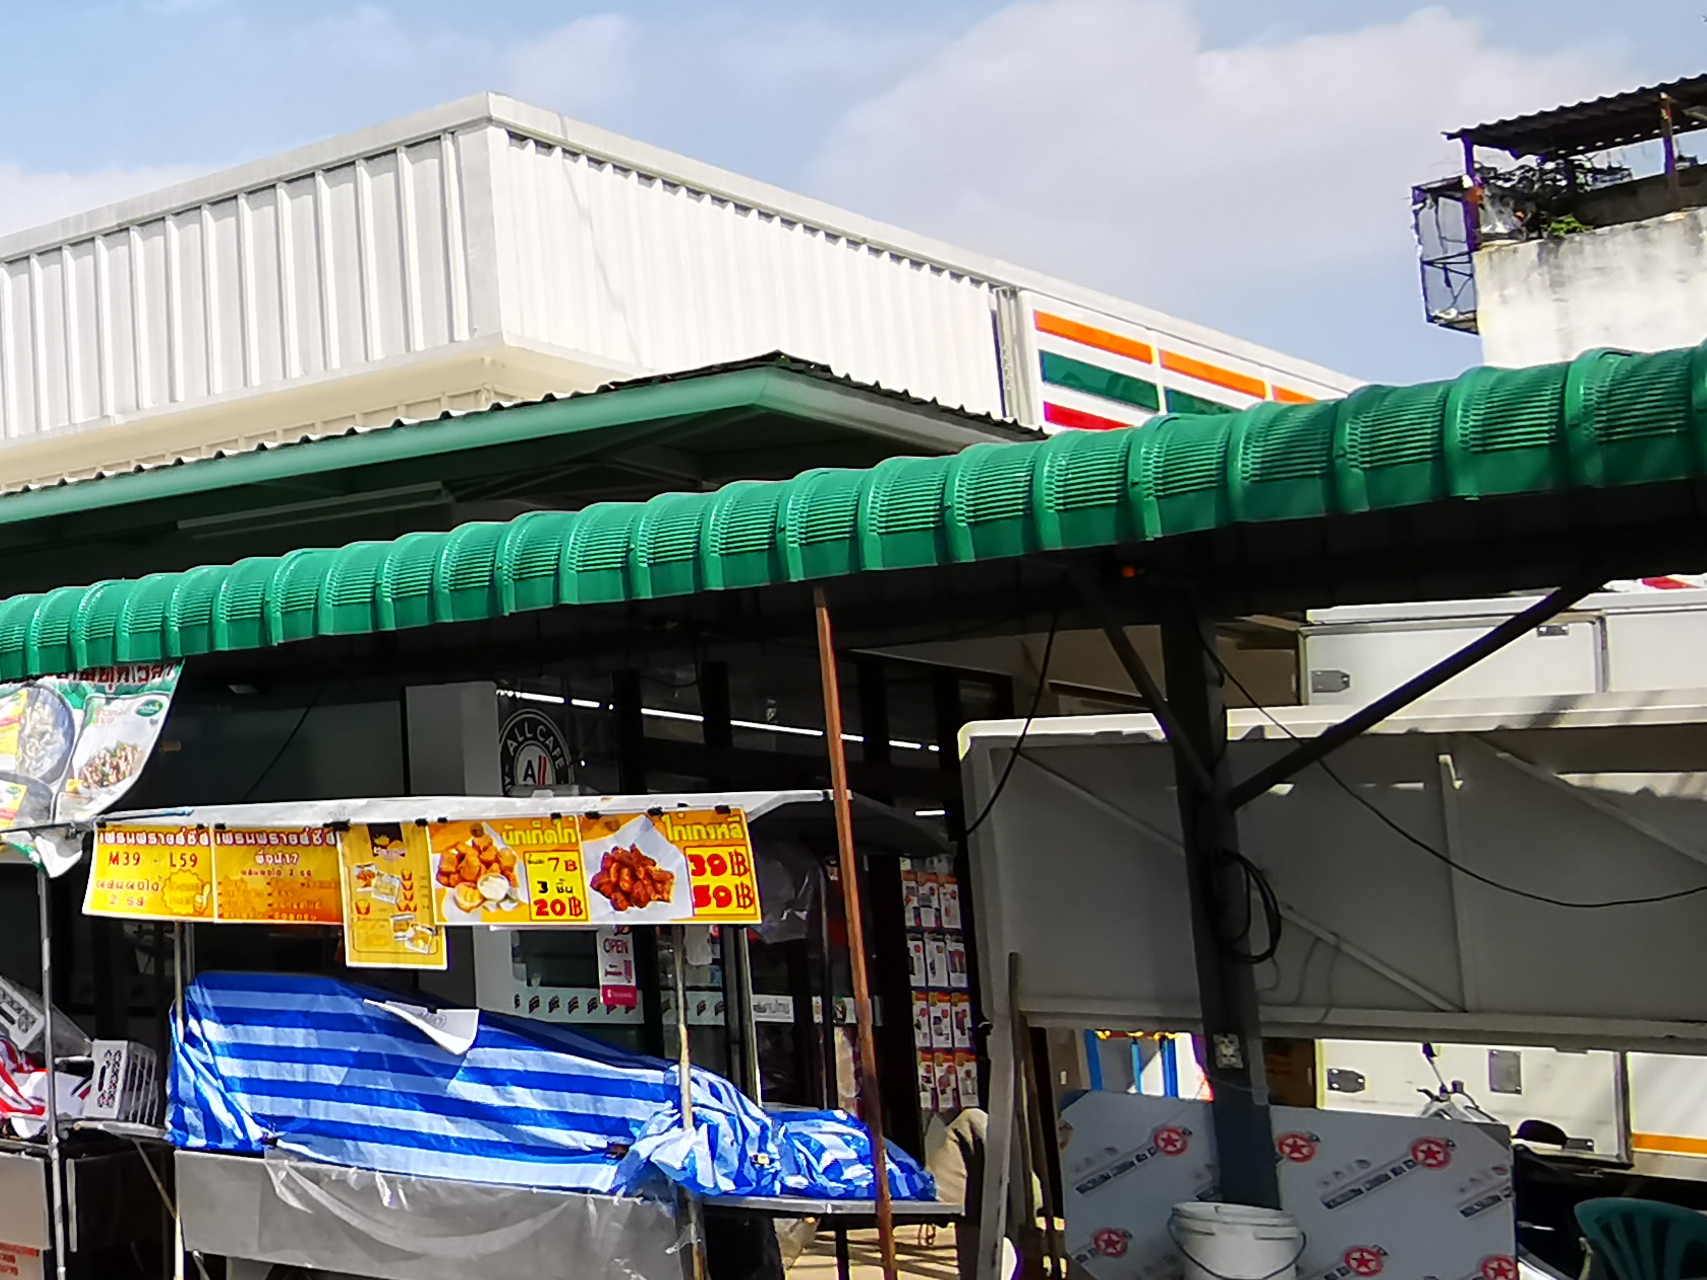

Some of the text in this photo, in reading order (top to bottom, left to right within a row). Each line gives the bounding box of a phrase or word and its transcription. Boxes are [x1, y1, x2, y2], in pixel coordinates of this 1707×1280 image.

[507, 721, 566, 770] ALL CAFE
[107, 851, 142, 867] M39
[169, 851, 198, 869] L59
